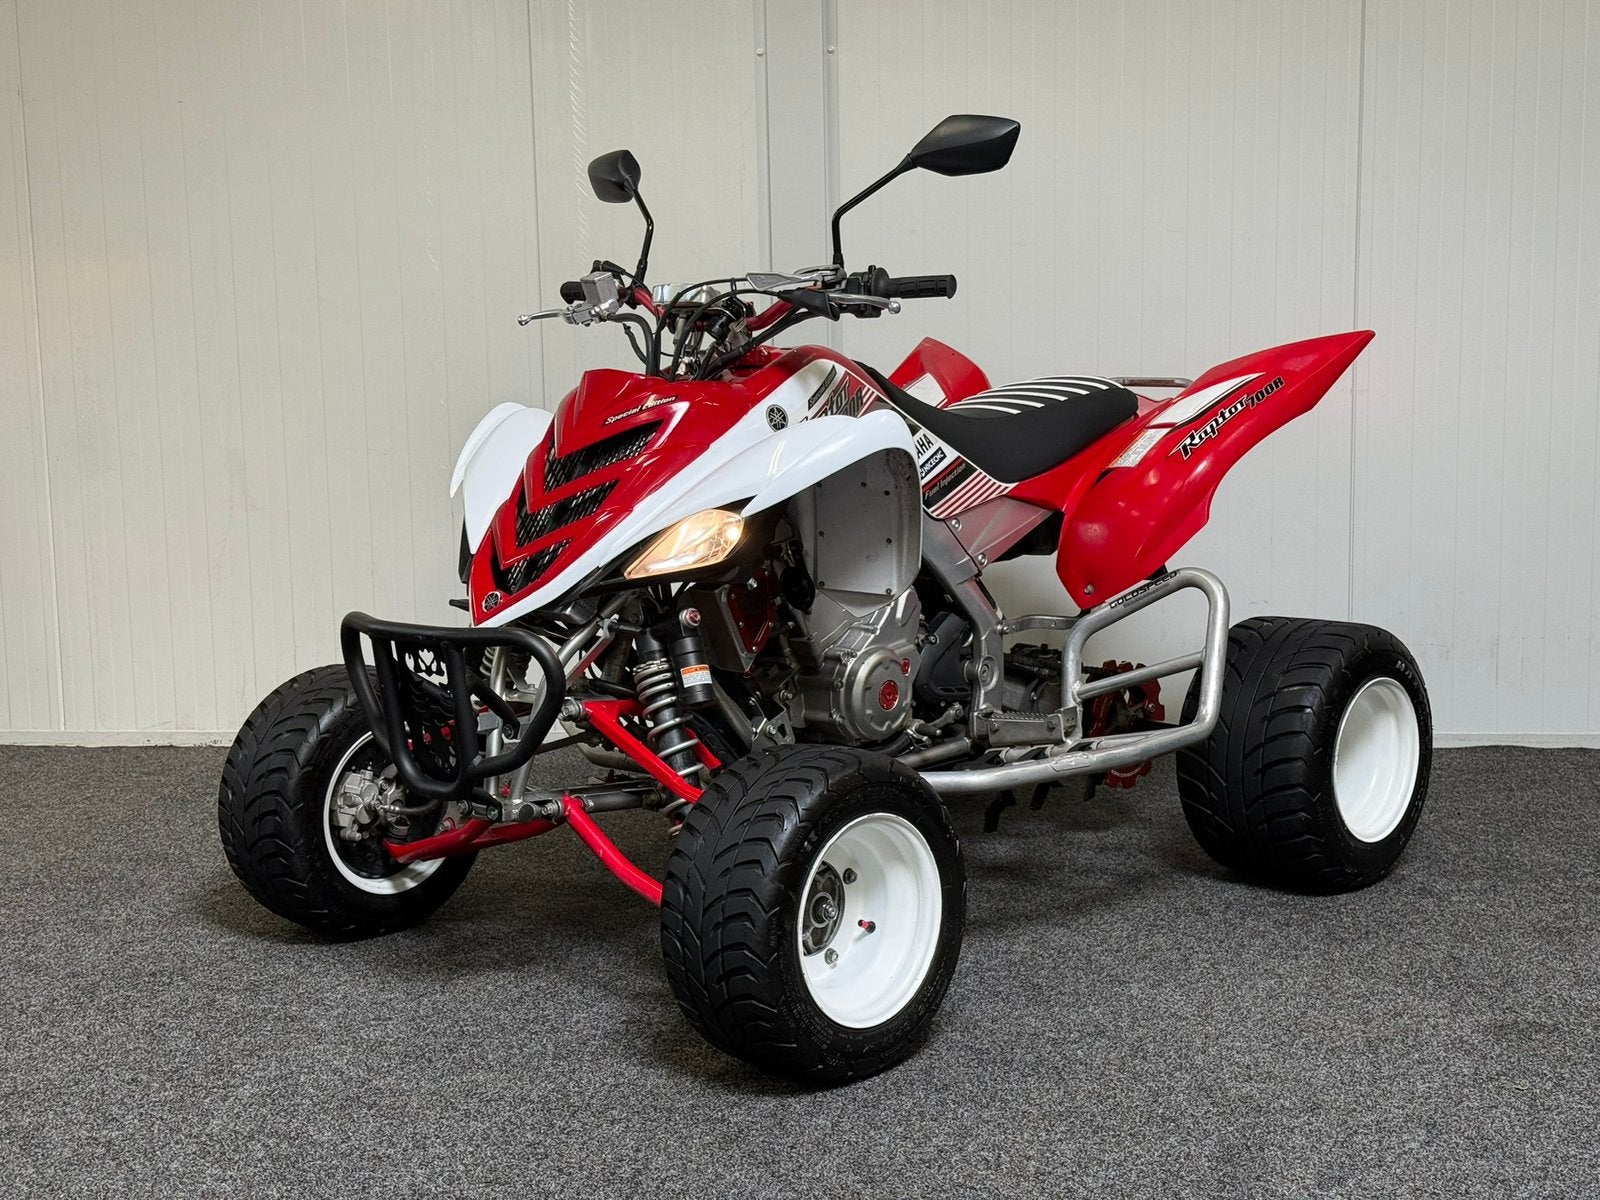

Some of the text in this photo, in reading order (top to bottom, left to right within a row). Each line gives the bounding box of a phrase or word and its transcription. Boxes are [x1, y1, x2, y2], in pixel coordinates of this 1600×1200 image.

[605, 405, 641, 425] Special
[1170, 394, 1249, 459] Raptor
[1246, 376, 1285, 409] 700R
[914, 433, 934, 459] AHA
[925, 463, 966, 501] Fuel Injection
